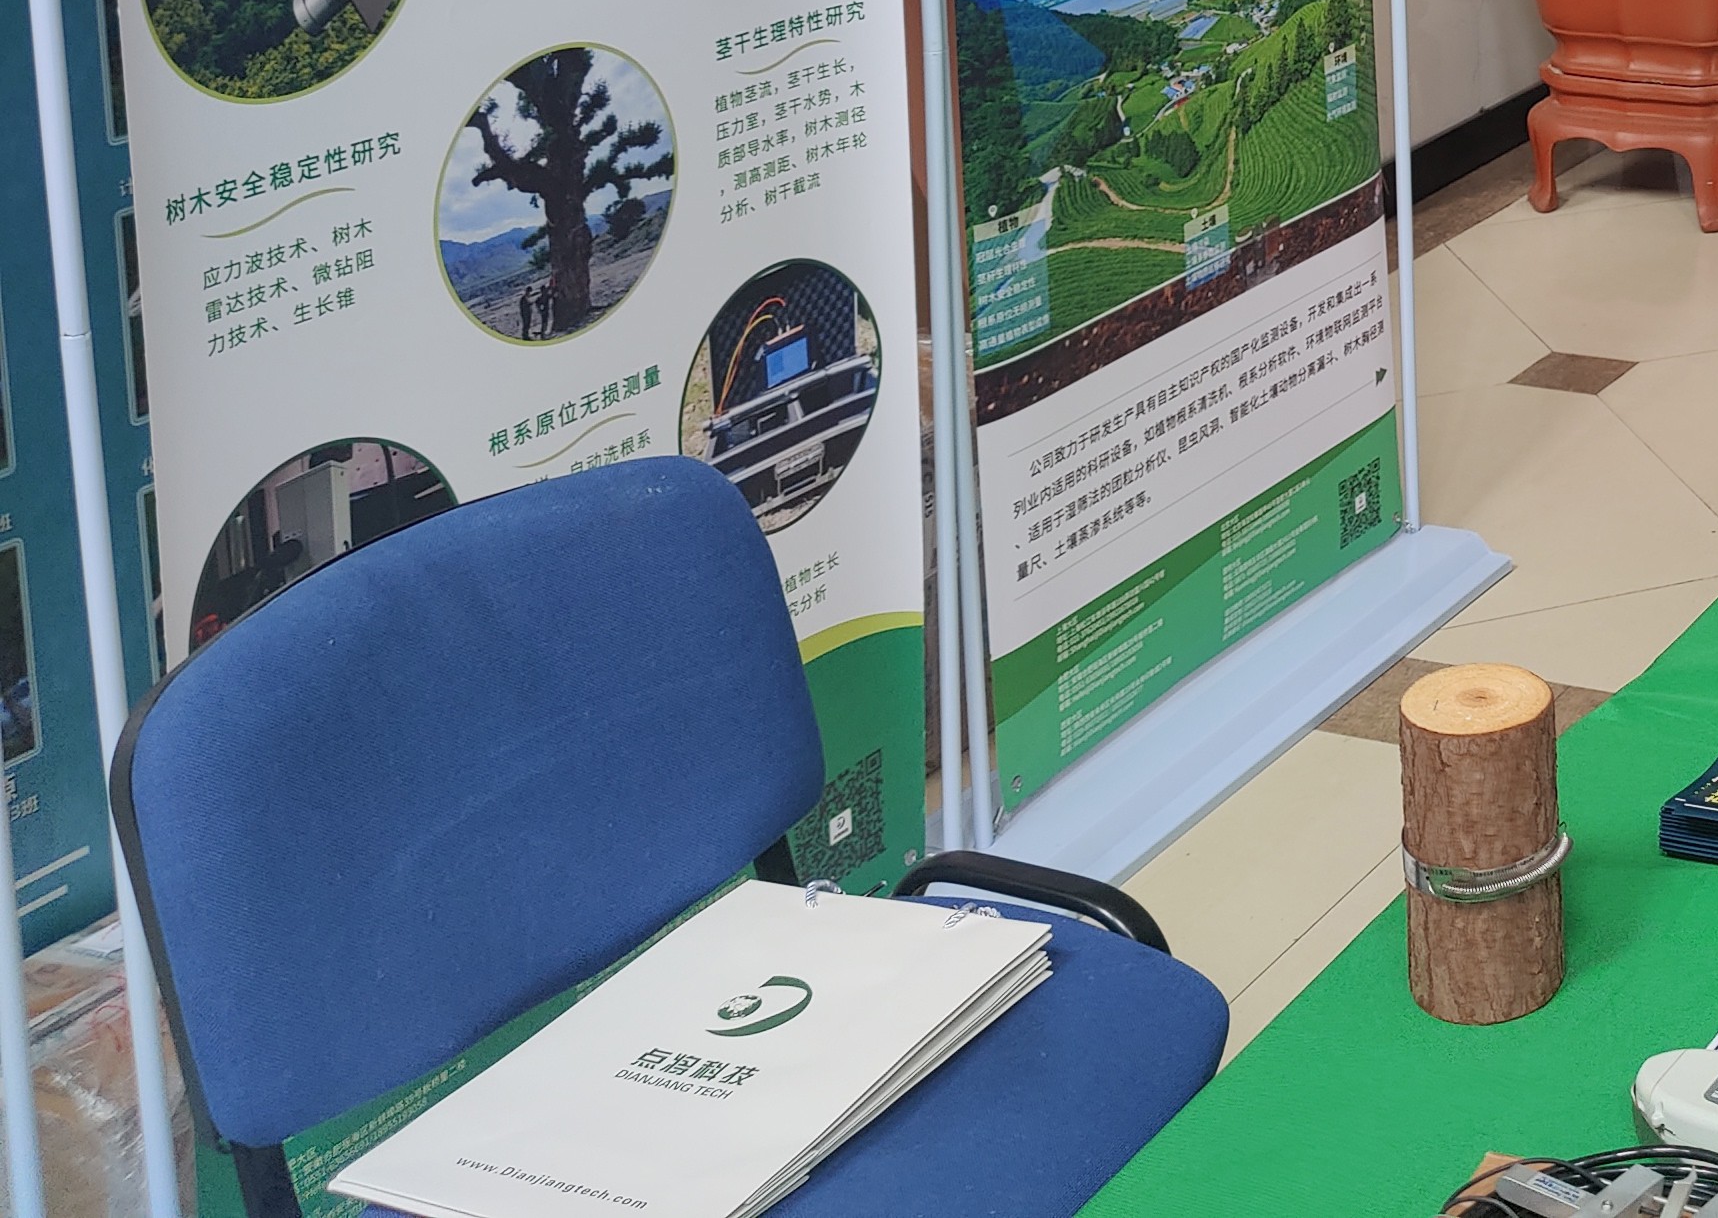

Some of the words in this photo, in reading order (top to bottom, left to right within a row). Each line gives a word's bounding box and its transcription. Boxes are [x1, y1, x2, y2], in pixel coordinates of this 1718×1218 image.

[715, 1, 866, 62] 茎干生理特性研究
[165, 131, 402, 226] 树木安全稳定性研究
[203, 218, 373, 290] 应力波技术、树木
[998, 216, 1019, 234] 植物
[205, 248, 375, 324] 雷达技术、微钻阻
[207, 287, 356, 357] 力技术、生长锥
[488, 364, 661, 458] 根系原位无损测量
[614, 1069, 694, 1094] DIANJIANG
[692, 1085, 734, 1101] TECH
[631, 1048, 760, 1086] 点将科技
[456, 1157, 648, 1210] www.Dianjiangtech.com
